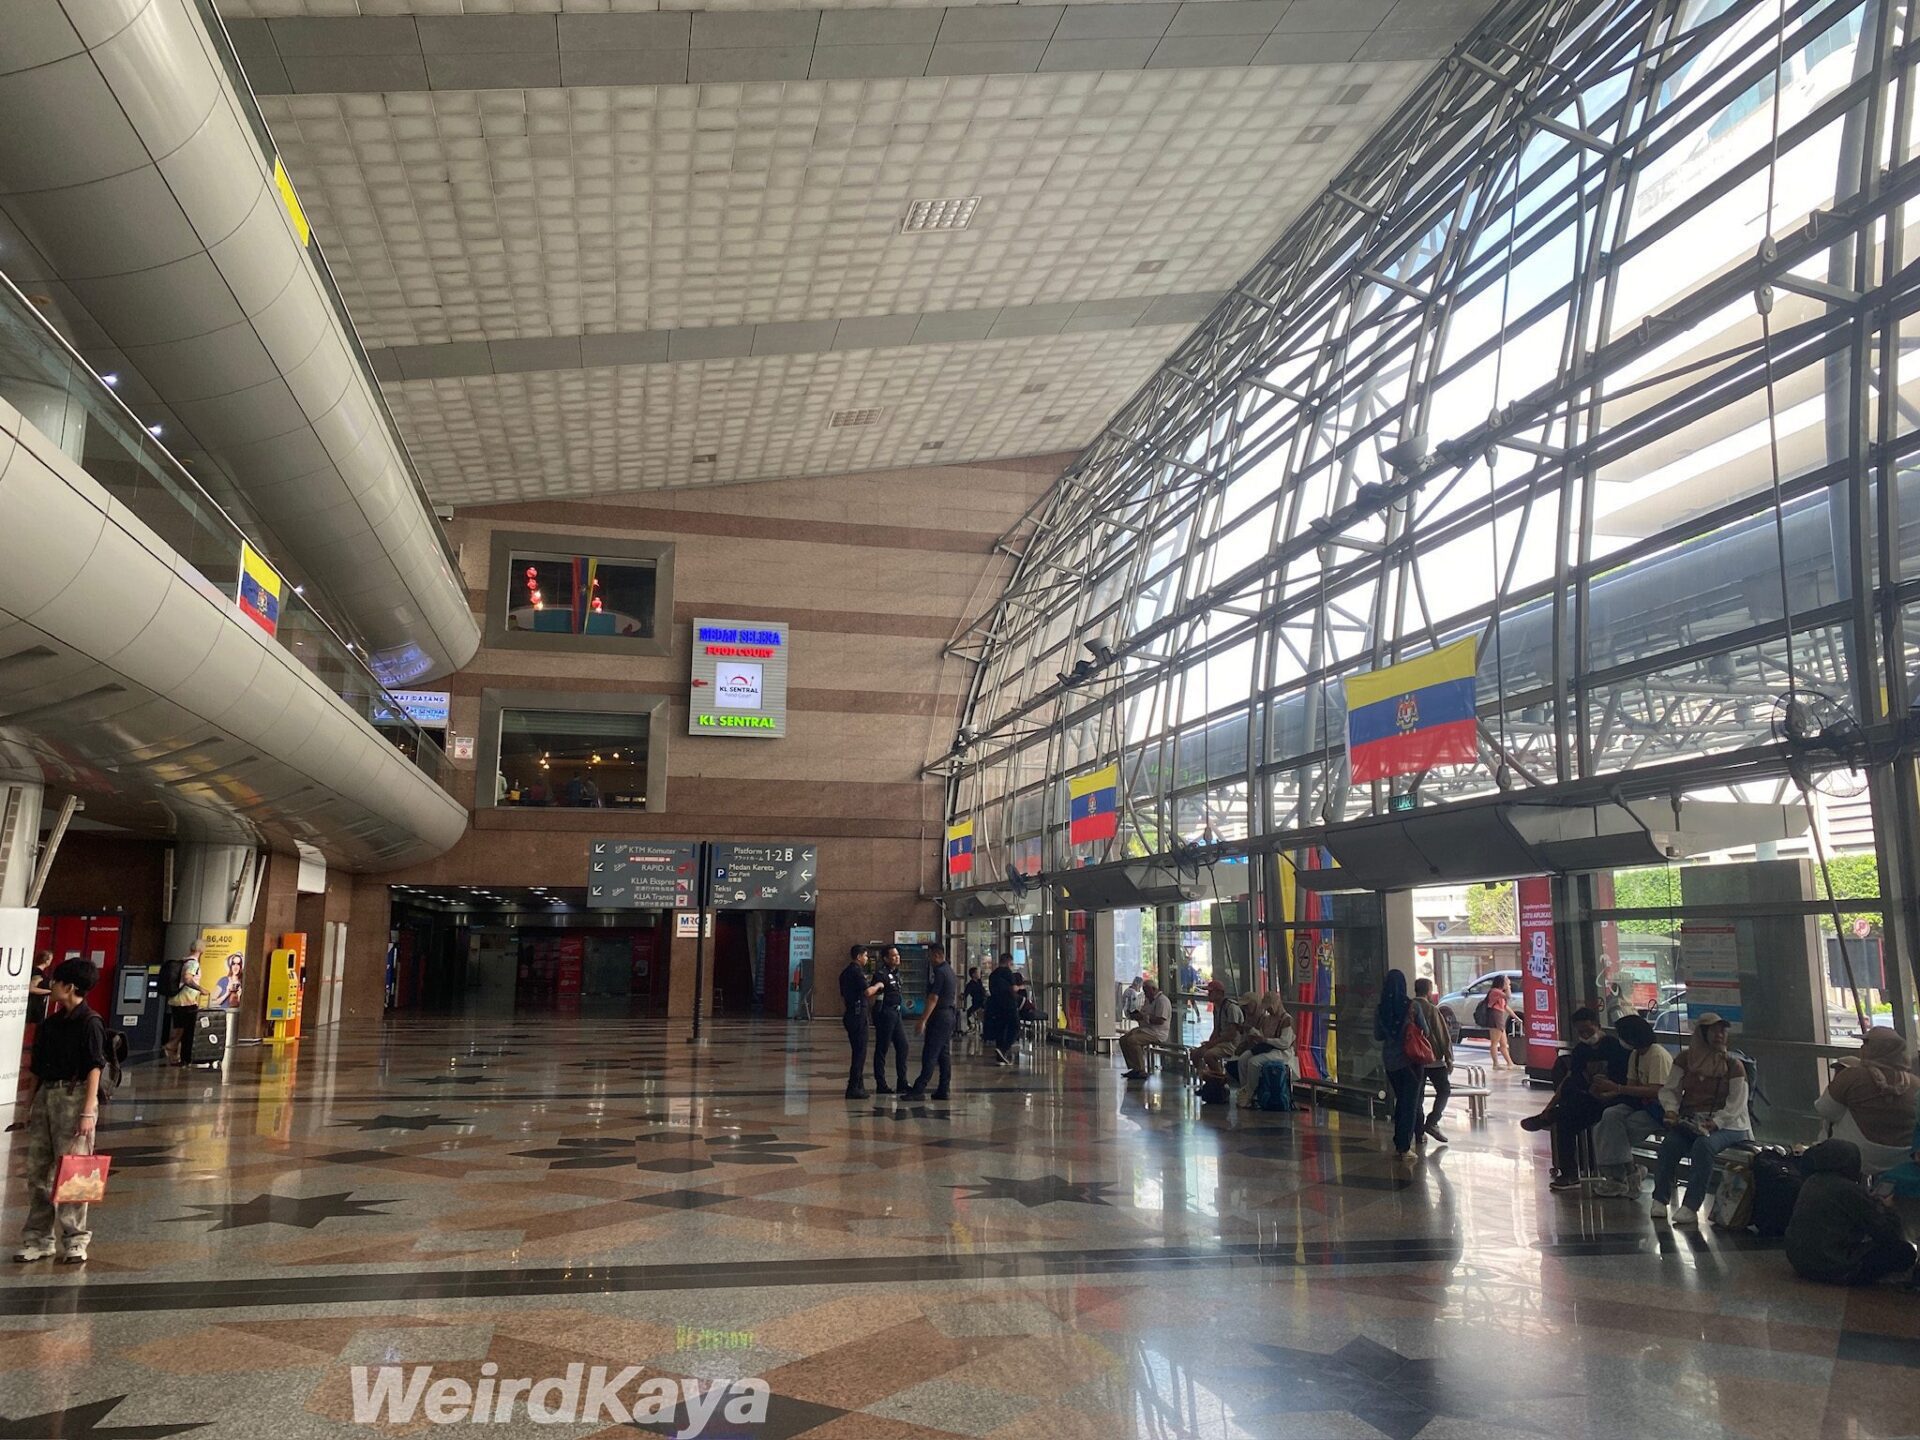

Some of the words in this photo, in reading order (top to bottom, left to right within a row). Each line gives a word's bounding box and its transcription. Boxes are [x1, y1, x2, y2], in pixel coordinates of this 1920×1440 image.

[700, 628, 737, 643] MEDAN
[706, 646, 736, 656] FOOD
[737, 648, 774, 658] COURT
[412, 694, 445, 702] DATANG
[699, 715, 715, 726] KL
[718, 716, 775, 729] SENTRAL
[647, 846, 676, 854] Komuter
[733, 847, 762, 855] Platform
[764, 849, 782, 861] 1-2
[784, 851, 793, 862] B
[641, 864, 664, 872] RAPID
[665, 864, 675, 872] KL
[728, 863, 751, 871] Medan
[649, 878, 675, 886] Ekspres
[714, 884, 732, 892] Teksi
[1531, 1021, 1555, 1031] airasia
